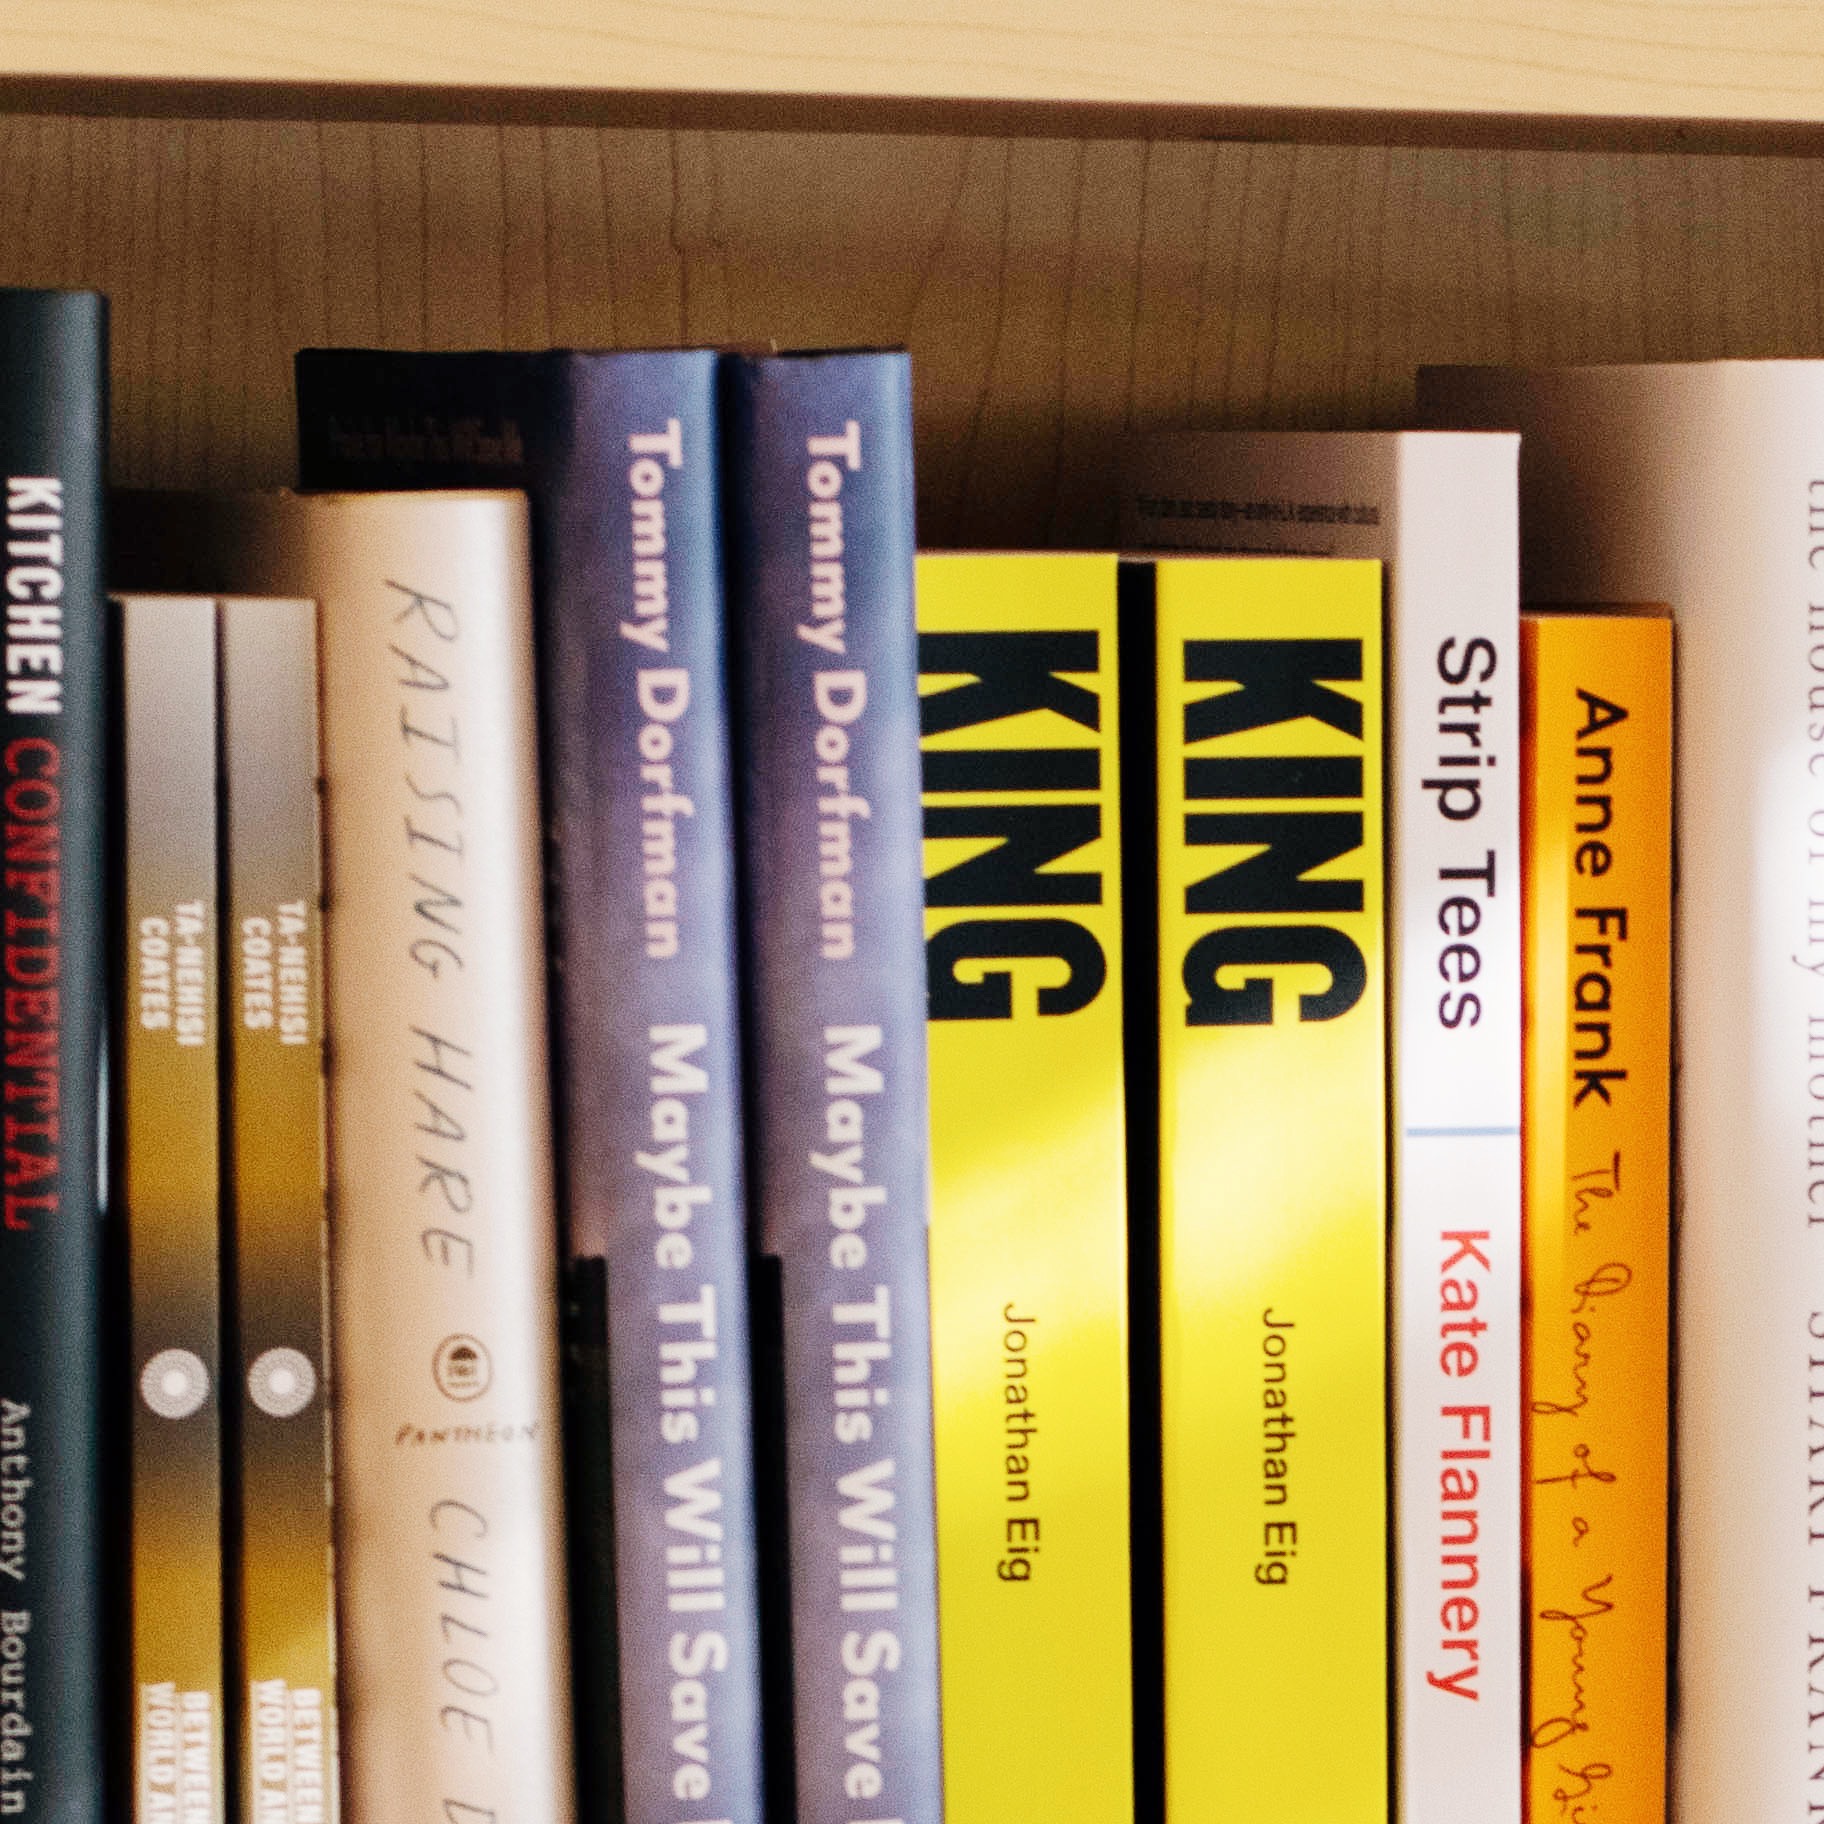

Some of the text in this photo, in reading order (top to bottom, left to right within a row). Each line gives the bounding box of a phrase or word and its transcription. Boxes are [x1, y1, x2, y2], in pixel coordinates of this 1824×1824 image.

[2, 477, 62, 1230] KITCHEN CONFIDENTIAL
[625, 418, 694, 958] Tommy Dorfman
[1182, 639, 1367, 1027] KING
[1420, 635, 1497, 1028] Strip Tees
[384, 578, 476, 1277] RAISING HARE
[1573, 688, 1629, 1108] Anne Frank
[645, 1023, 712, 1270] Maybe
[656, 1288, 716, 1444] This
[662, 1460, 727, 1612] Will
[1427, 1230, 1491, 1702] Kate Flannery
[428, 1498, 498, 1753] CHLOE
[670, 1631, 728, 1800] Save
